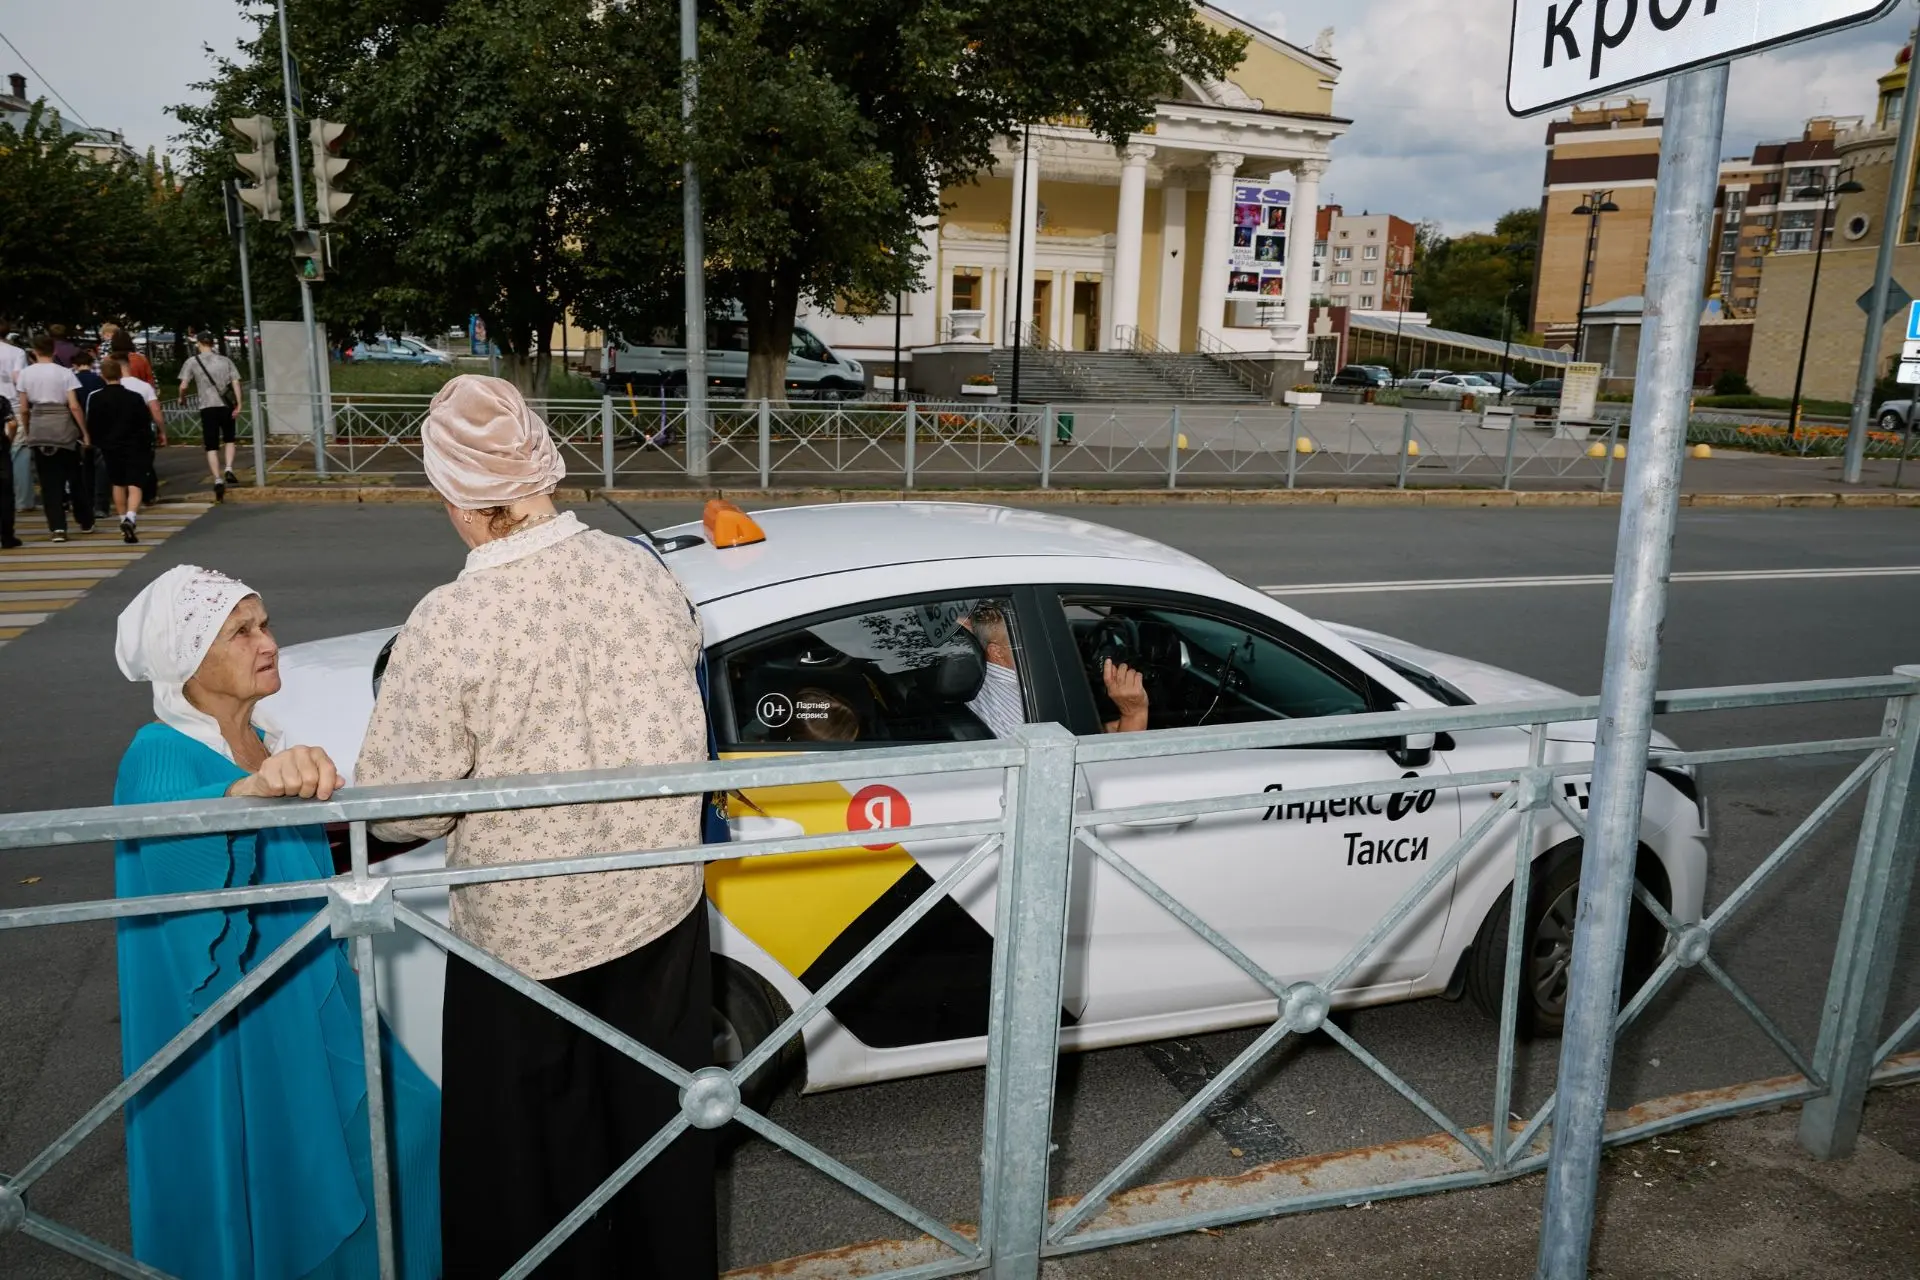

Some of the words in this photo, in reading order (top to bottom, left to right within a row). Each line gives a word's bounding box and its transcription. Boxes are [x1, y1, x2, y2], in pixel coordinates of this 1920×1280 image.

[763, 702, 786, 718] 0+
[796, 701, 830, 711] Партнёр
[796, 711, 829, 720] сервиса
[865, 796, 892, 831] Я
[1344, 832, 1429, 866] Такси
